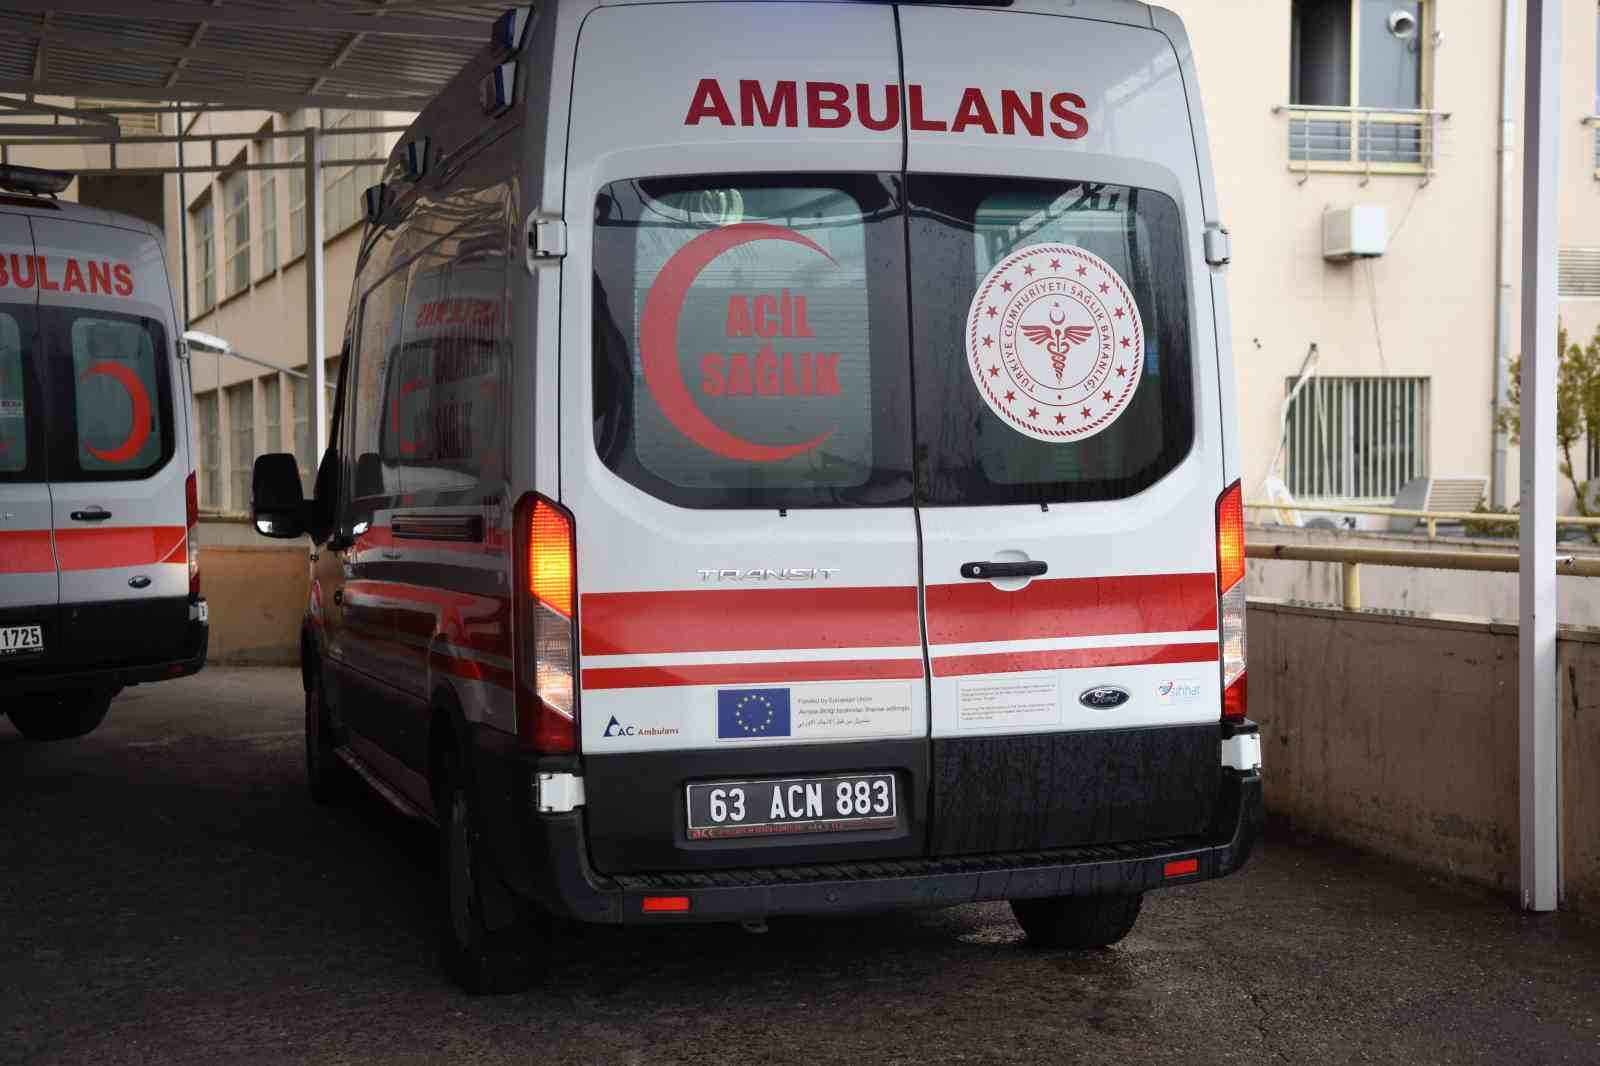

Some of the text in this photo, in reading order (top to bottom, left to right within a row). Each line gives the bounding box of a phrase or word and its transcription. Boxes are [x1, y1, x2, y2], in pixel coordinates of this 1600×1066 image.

[684, 78, 1089, 140] AMBULANS
[726, 288, 816, 337] ACİL
[702, 343, 841, 397] SAĞLIK
[696, 567, 840, 582] TRANSIT
[3, 628, 40, 647] 1725
[709, 779, 889, 823] 63 ACN 883
